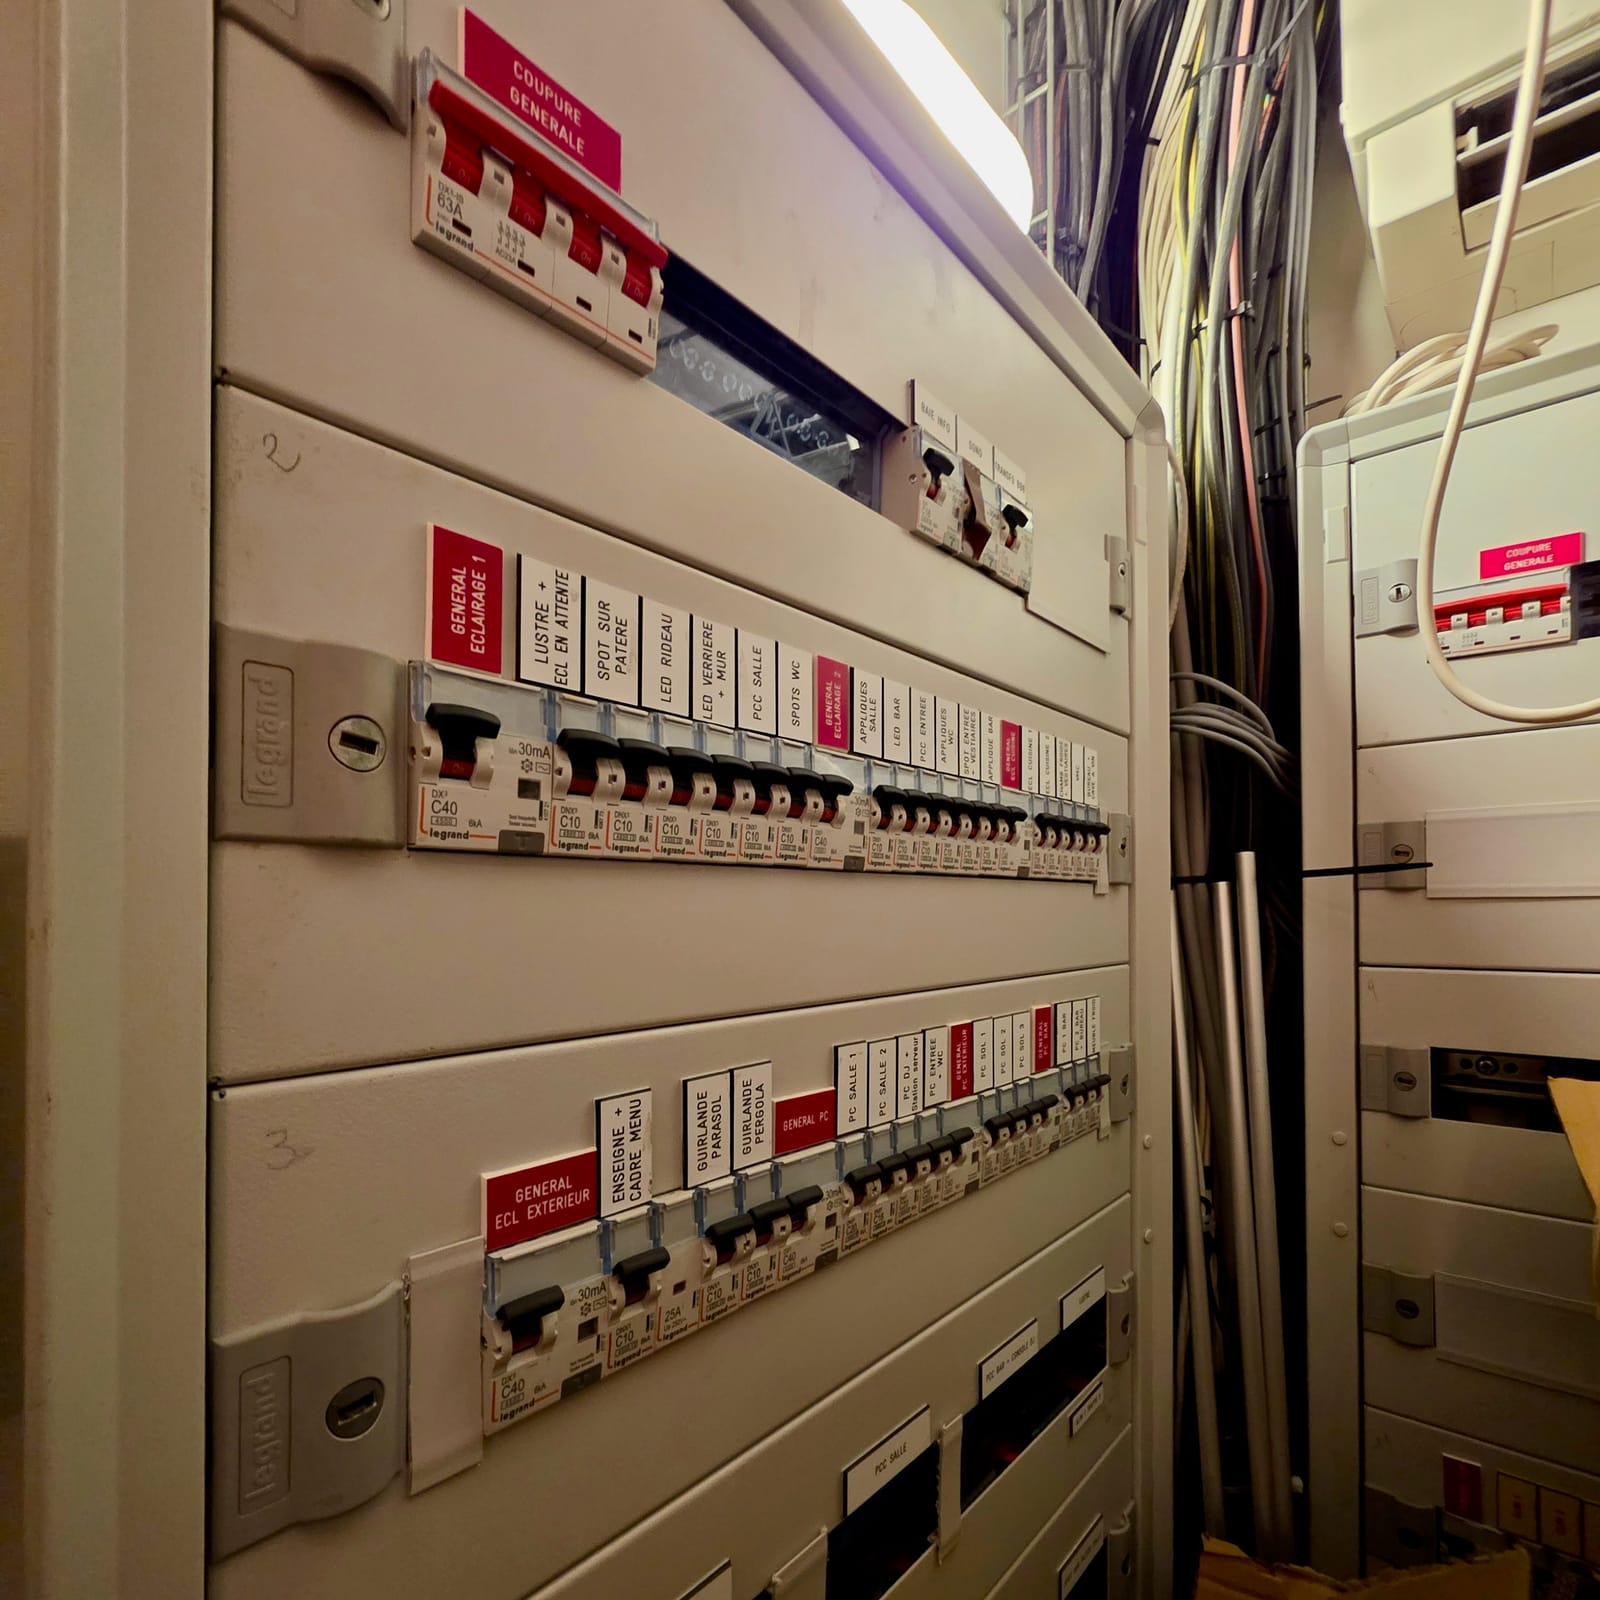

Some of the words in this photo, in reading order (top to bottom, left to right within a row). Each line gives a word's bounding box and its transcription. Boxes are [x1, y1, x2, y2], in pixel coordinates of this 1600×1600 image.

[513, 60, 582, 128] COUPURE
[509, 86, 585, 157] GENERALE
[437, 192, 463, 219] 63A
[436, 220, 474, 252] legrand
[262, 433, 301, 473] 2
[472, 555, 486, 563] 1
[1505, 542, 1552, 558] COUPURE
[1503, 553, 1554, 572] GENERALE
[538, 581, 546, 591] +
[451, 566, 467, 635] GENERAL
[555, 569, 569, 630] ATTENTE
[471, 571, 486, 654] ECLAIRAGE
[598, 600, 610, 632] SUR
[535, 600, 550, 664] LUSTRE
[661, 613, 673, 667] RIDEAU
[555, 635, 569, 652] EN
[615, 617, 628, 675] PATERE
[597, 640, 610, 681] SPOT
[703, 621, 713, 686] VERRIERE
[554, 662, 568, 686] ECL
[717, 650, 727, 681] MUR
[752, 645, 762, 687] SALLE
[792, 660, 800, 680] WC
[661, 676, 672, 703] LED
[703, 694, 713, 720] LED
[752, 694, 762, 720] PCC
[792, 687, 800, 727] SPOTS
[825, 680, 833, 726] GENERAL
[869, 698, 877, 733] SALLE
[246, 676, 287, 800] legrand
[948, 730, 954, 745] WC
[518, 742, 551, 759] 30mA
[431, 800, 458, 815] C40
[468, 819, 482, 828] 6kA
[560, 815, 581, 828] C10
[614, 819, 632, 833] C10
[662, 823, 679, 835] C10
[429, 827, 470, 840] legrand
[705, 828, 721, 839] C10
[745, 831, 759, 842] C10
[781, 833, 794, 843] C10
[558, 840, 589, 851] legrand
[612, 843, 639, 853] legrand
[660, 846, 686, 856] legrand
[703, 849, 727, 858] legrand
[871, 843, 882, 852] C10
[897, 845, 908, 854] C10
[743, 851, 764, 861] legrand
[779, 852, 798, 861] legrand
[937, 1050, 943, 1067] WC
[1000, 1062, 1006, 1074] PC
[1019, 1056, 1024, 1068] PC
[903, 1065, 910, 1079] DJ
[980, 1065, 986, 1078] PC
[849, 1063, 857, 1100] SALLE
[930, 1083, 936, 1096] PC
[962, 1078, 967, 1090] PC
[903, 1085, 910, 1100] PC
[615, 1108, 622, 1117] +
[742, 1078, 752, 1155] GUIRLANDE
[755, 1083, 764, 1145] PERGOLA
[849, 1109, 857, 1123] PC
[879, 1101, 886, 1117] PC
[630, 1099, 642, 1143] MENU
[711, 1095, 721, 1159] PARASOL
[783, 1115, 815, 1131] GENERAL
[819, 1110, 829, 1122] PC
[697, 1090, 708, 1171] GUIRLANDE
[613, 1126, 625, 1203] ENSEIGNE
[630, 1149, 642, 1202] CADRE
[515, 1175, 572, 1203] GENERAL
[495, 1213, 519, 1230] ECL
[527, 1188, 590, 1220] EXTERIEUR
[746, 1269, 761, 1282] C10
[578, 1281, 607, 1301] 30mA
[707, 1288, 722, 1303] C10
[665, 1307, 681, 1320] 25A
[706, 1304, 728, 1320] legrand
[615, 1331, 634, 1347] C10
[663, 1324, 688, 1340] legrand
[614, 1348, 641, 1368] legrand
[501, 1379, 525, 1399] C40
[500, 1398, 535, 1422] legrand
[889, 1441, 908, 1464] SALLE
